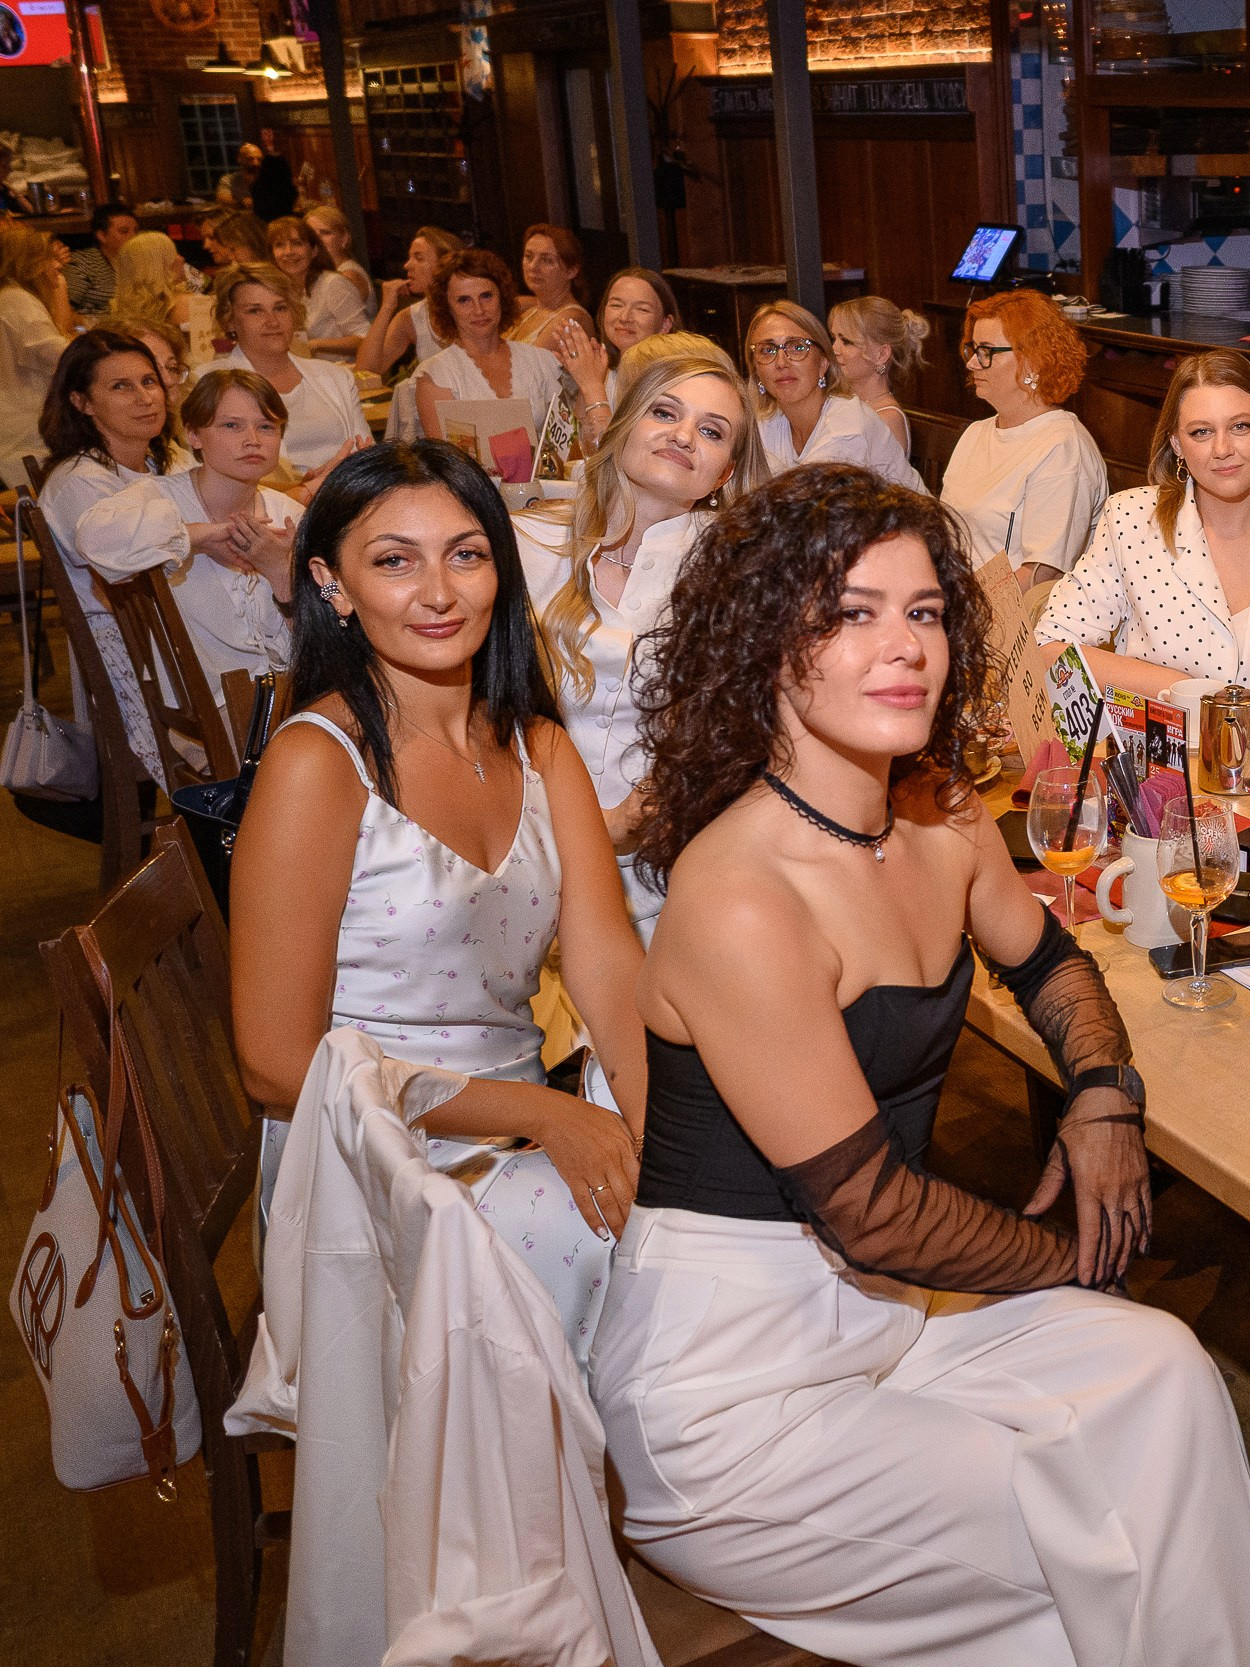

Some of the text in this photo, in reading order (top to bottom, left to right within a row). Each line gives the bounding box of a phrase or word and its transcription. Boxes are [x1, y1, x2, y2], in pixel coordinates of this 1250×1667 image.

[550, 422, 568, 451] 402
[1005, 621, 1029, 684] СТЕТИКА
[1022, 670, 1033, 697] ВО
[1065, 693, 1096, 741] 403
[1106, 703, 1134, 718] РУССКИЙ
